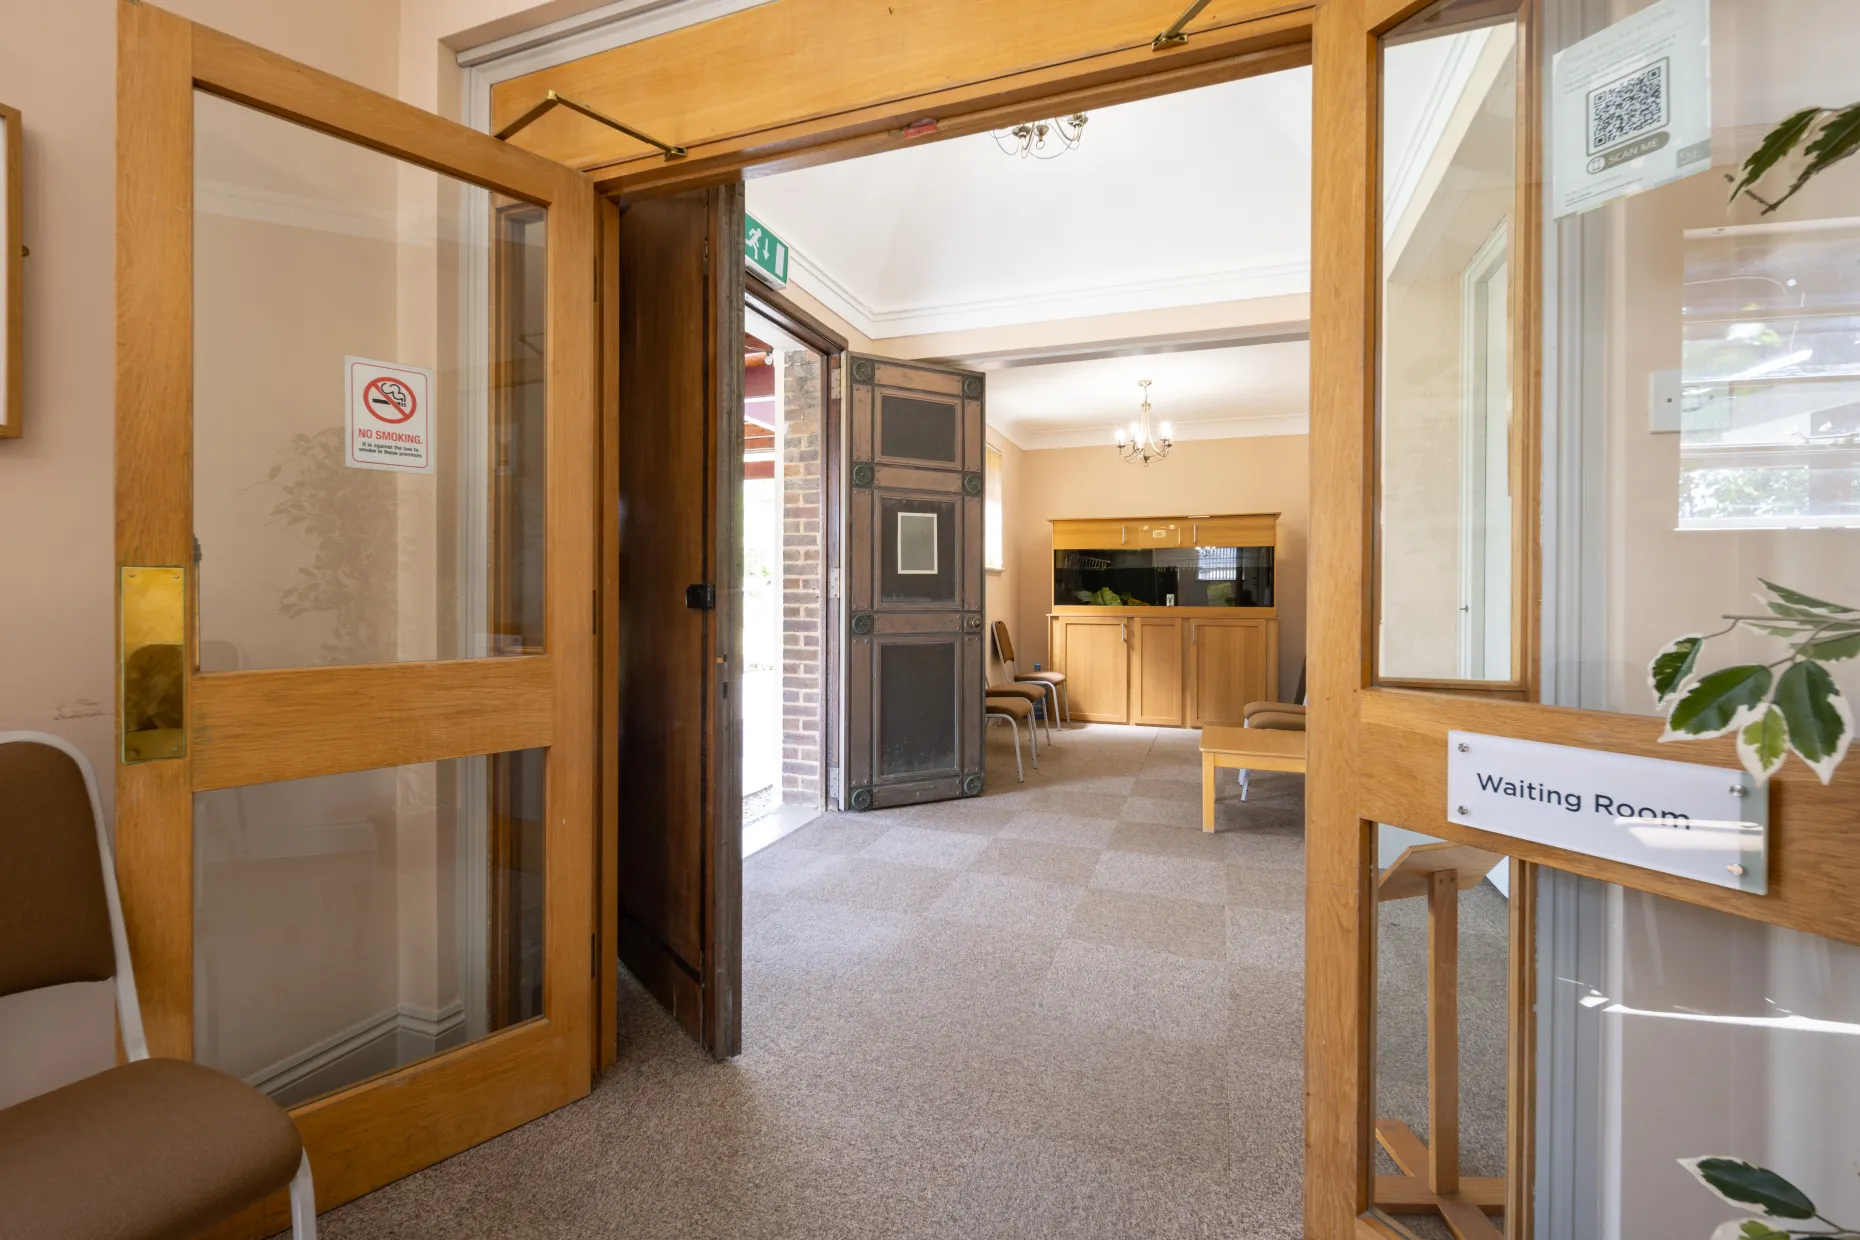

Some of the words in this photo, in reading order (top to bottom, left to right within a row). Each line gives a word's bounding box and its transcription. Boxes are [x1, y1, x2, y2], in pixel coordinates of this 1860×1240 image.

[1608, 146, 1639, 163] SCAN
[1640, 138, 1659, 152] ME
[358, 428, 373, 439] NO
[1476, 772, 1582, 813] Waiting
[1594, 793, 1691, 829] Room
